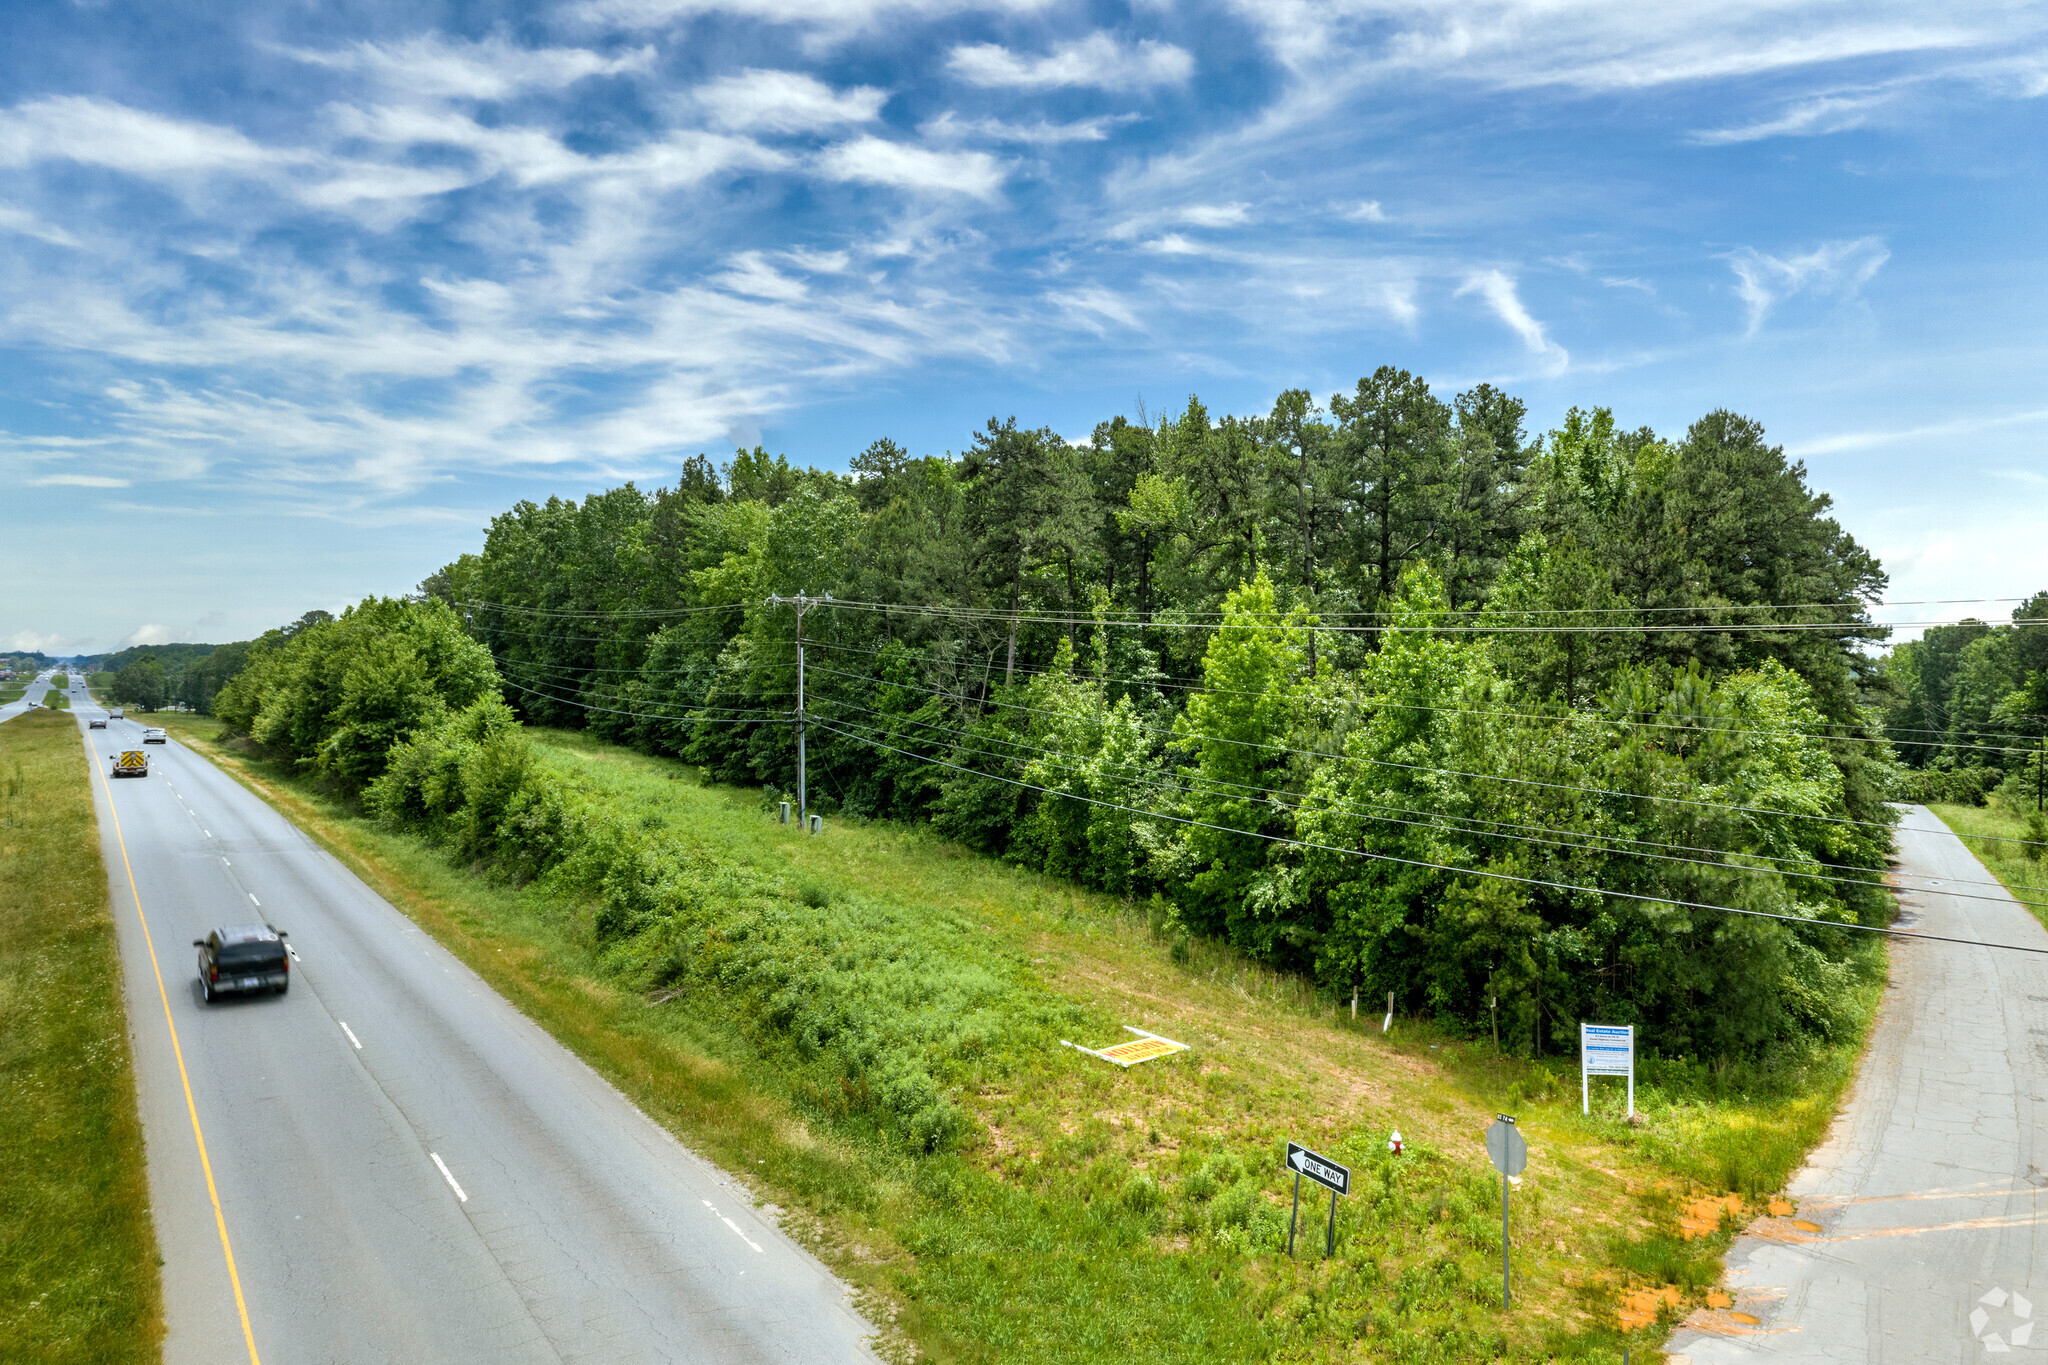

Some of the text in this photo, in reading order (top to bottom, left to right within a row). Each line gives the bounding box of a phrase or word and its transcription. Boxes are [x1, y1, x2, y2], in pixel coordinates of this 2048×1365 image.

[1102, 1040, 1167, 1058] AUCTION
[1304, 1158, 1342, 1184] ONE WAY
